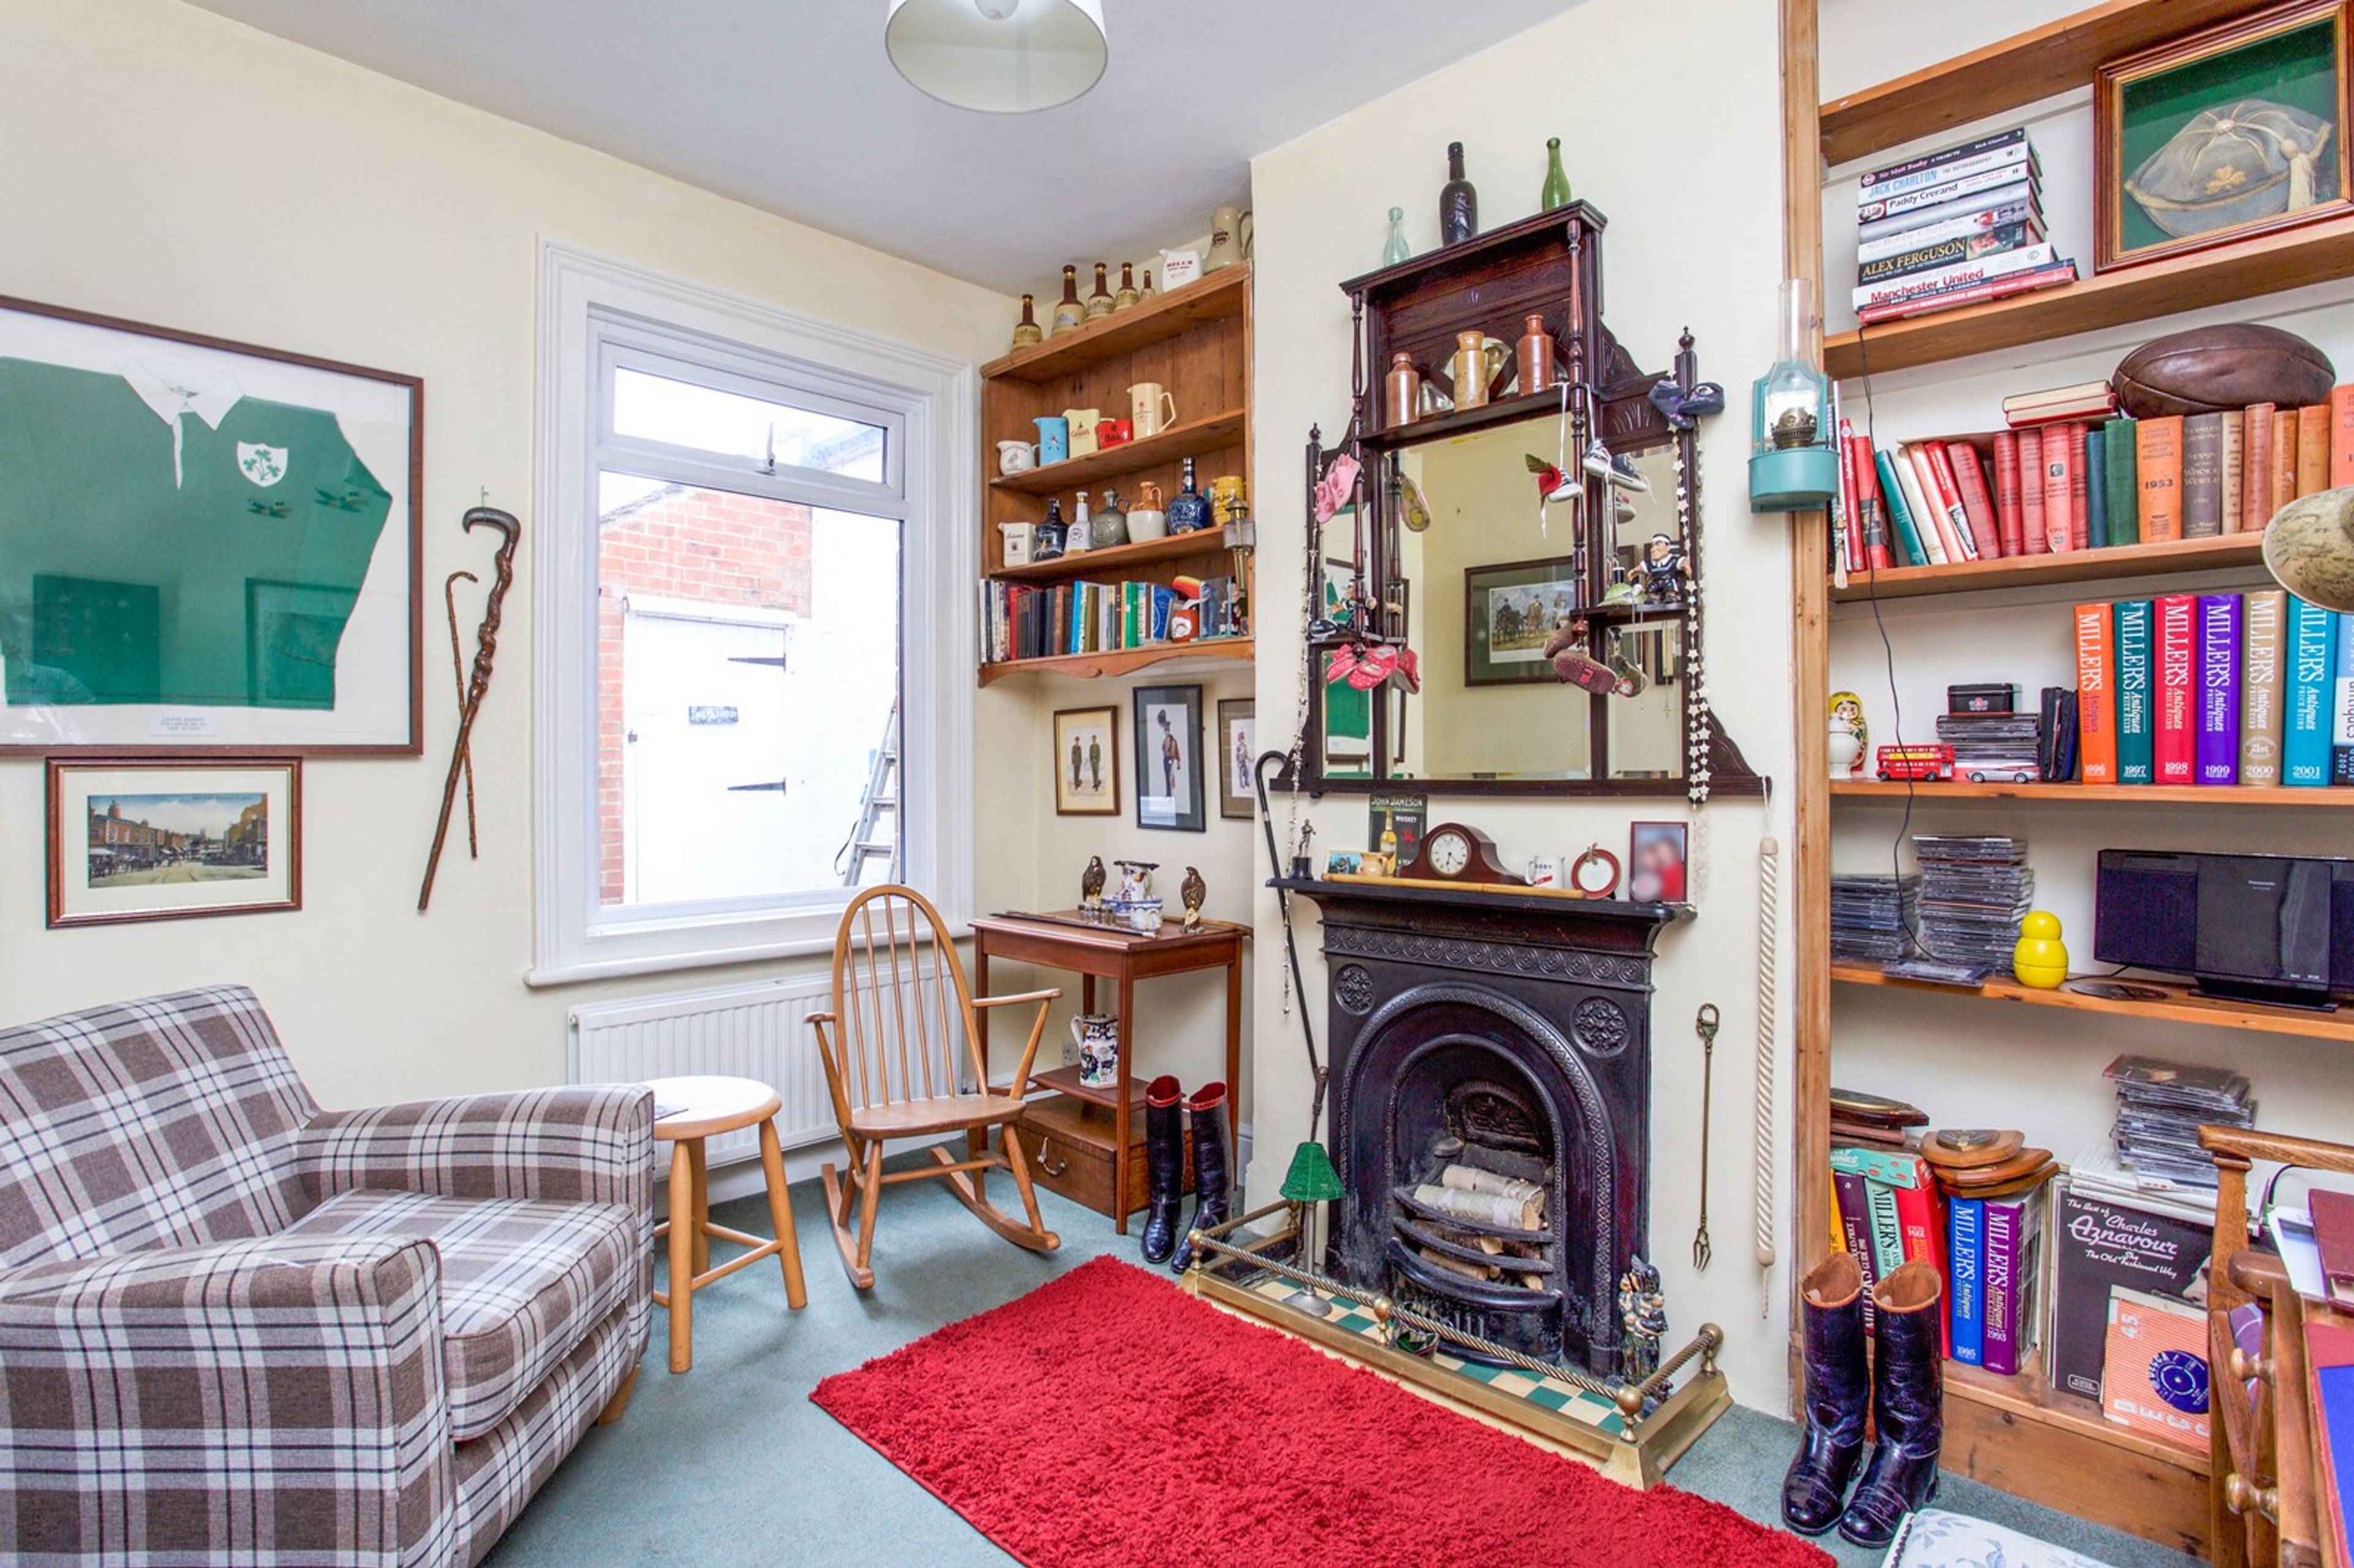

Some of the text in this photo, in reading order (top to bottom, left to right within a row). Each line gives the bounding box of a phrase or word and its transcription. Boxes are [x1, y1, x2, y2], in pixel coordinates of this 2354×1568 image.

[1868, 183, 1891, 197] JACK
[1893, 170, 1937, 191] CHARLTON
[1889, 183, 1958, 208] Paddy Crerand
[1862, 258, 1895, 276] ALEX
[1897, 238, 1966, 267] FERGUSON
[1870, 280, 1939, 303] Manchester
[1942, 267, 1984, 286] United
[2145, 478, 2174, 490] 1953
[2090, 693, 2100, 734] Antiques
[2131, 691, 2143, 734] Antiques
[2173, 688, 2185, 729] Antiques
[2214, 688, 2227, 732] Antiques
[2257, 685, 2271, 729] Antiques
[2306, 685, 2320, 731] Antiques
[2085, 764, 2106, 775] 1996
[2124, 764, 2146, 775] 1997
[2165, 761, 2188, 773] 1998
[2205, 764, 2230, 775] 1999
[2245, 764, 2274, 775] 2000
[2293, 764, 2320, 775] 2001
[2338, 753, 2347, 775] 2002
[1371, 797, 1423, 807] JOHN JAMESON
[2067, 1198, 2110, 1217] The Best of
[2067, 1214, 2178, 1257] Aznavour
[2105, 1215, 2158, 1236] Charles
[2085, 1249, 2177, 1279] The Old Fashioned Way
[1962, 1279, 1973, 1320] Antiques
[1995, 1287, 2006, 1330] Antiques
[1987, 1330, 2006, 1341] 1993
[2120, 1314, 2139, 1339] 45
[2147, 1352, 2170, 1379] DECCA
[2114, 1399, 2211, 1437] DECC
